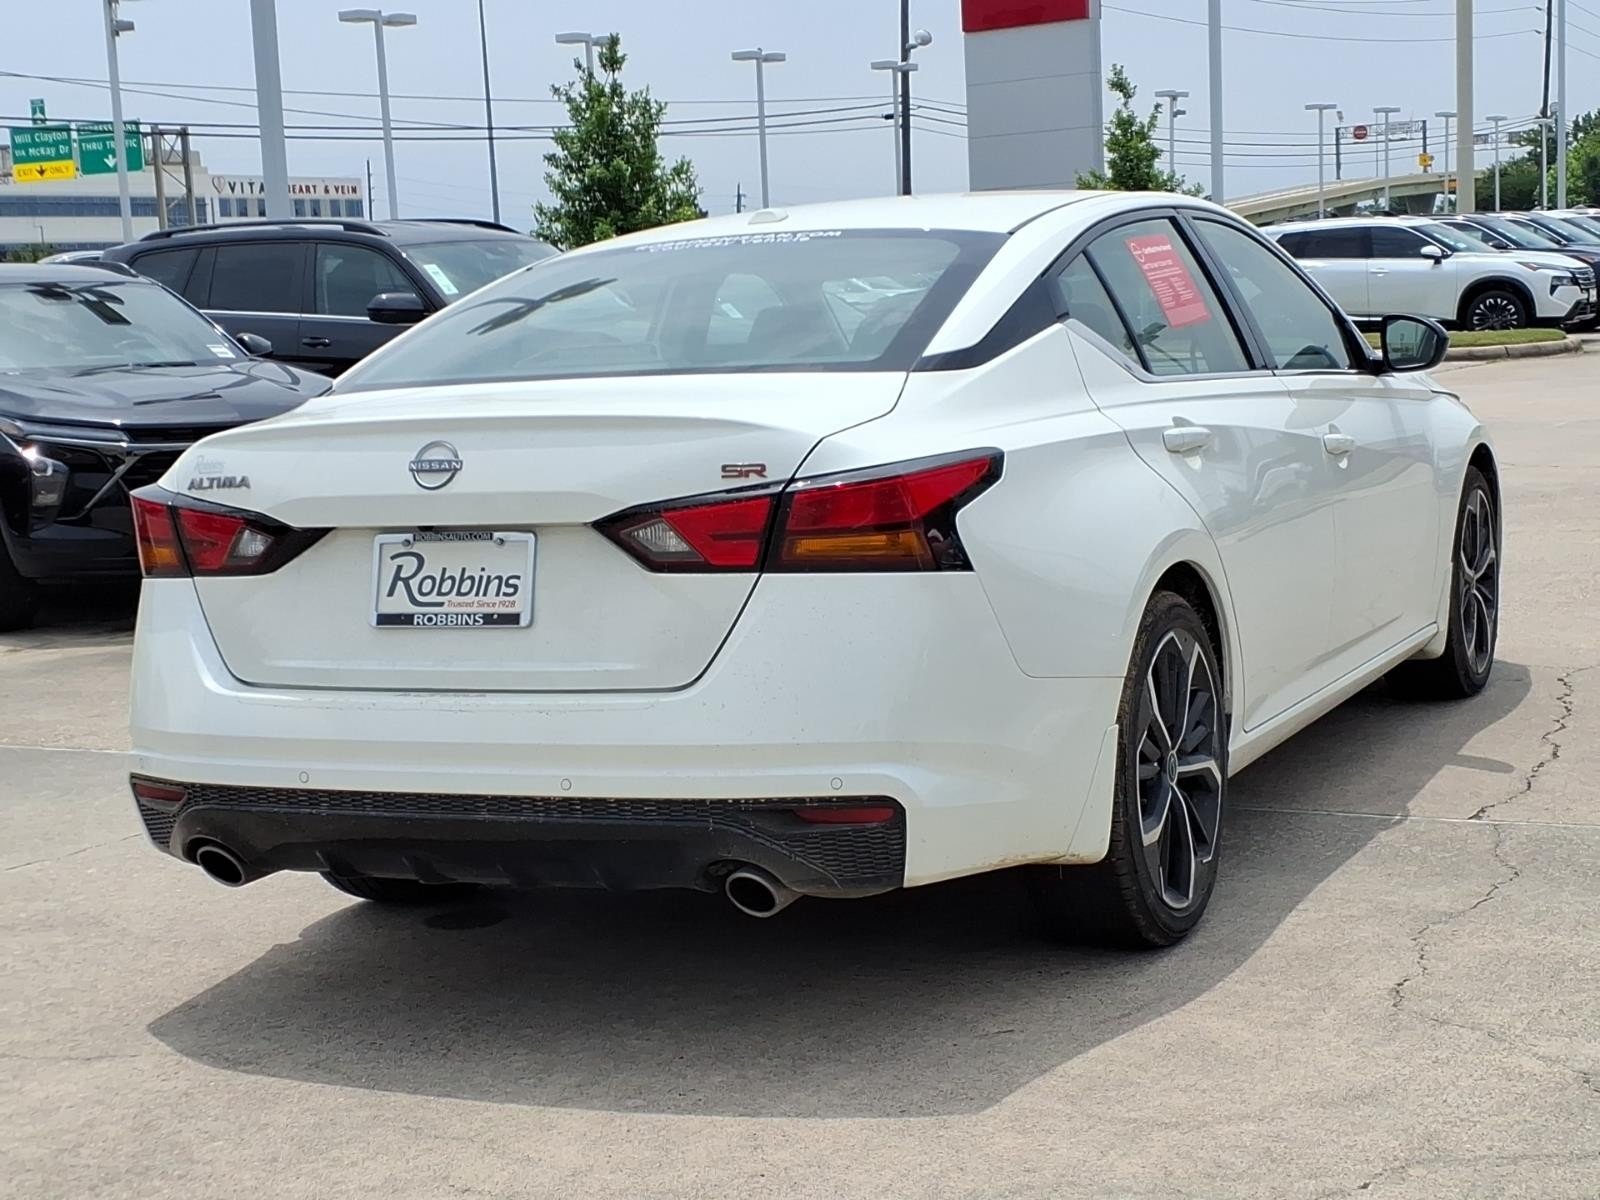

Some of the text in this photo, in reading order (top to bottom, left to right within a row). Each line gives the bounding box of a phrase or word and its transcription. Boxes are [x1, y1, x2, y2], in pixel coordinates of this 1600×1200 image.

[14, 131, 68, 144] Will Clayton
[28, 147, 56, 157] McKay
[59, 144, 70, 154] Dr
[81, 139, 137, 151] THRU TRFIC
[324, 185, 330, 194] &
[334, 185, 357, 194] VEIN
[410, 461, 461, 470] NISSAN
[721, 463, 768, 479] SR
[187, 476, 250, 490] ALTIMA
[386, 551, 521, 607] Robbins
[447, 600, 516, 608] Trusted Since 1928
[413, 614, 484, 626] ROBBINS
